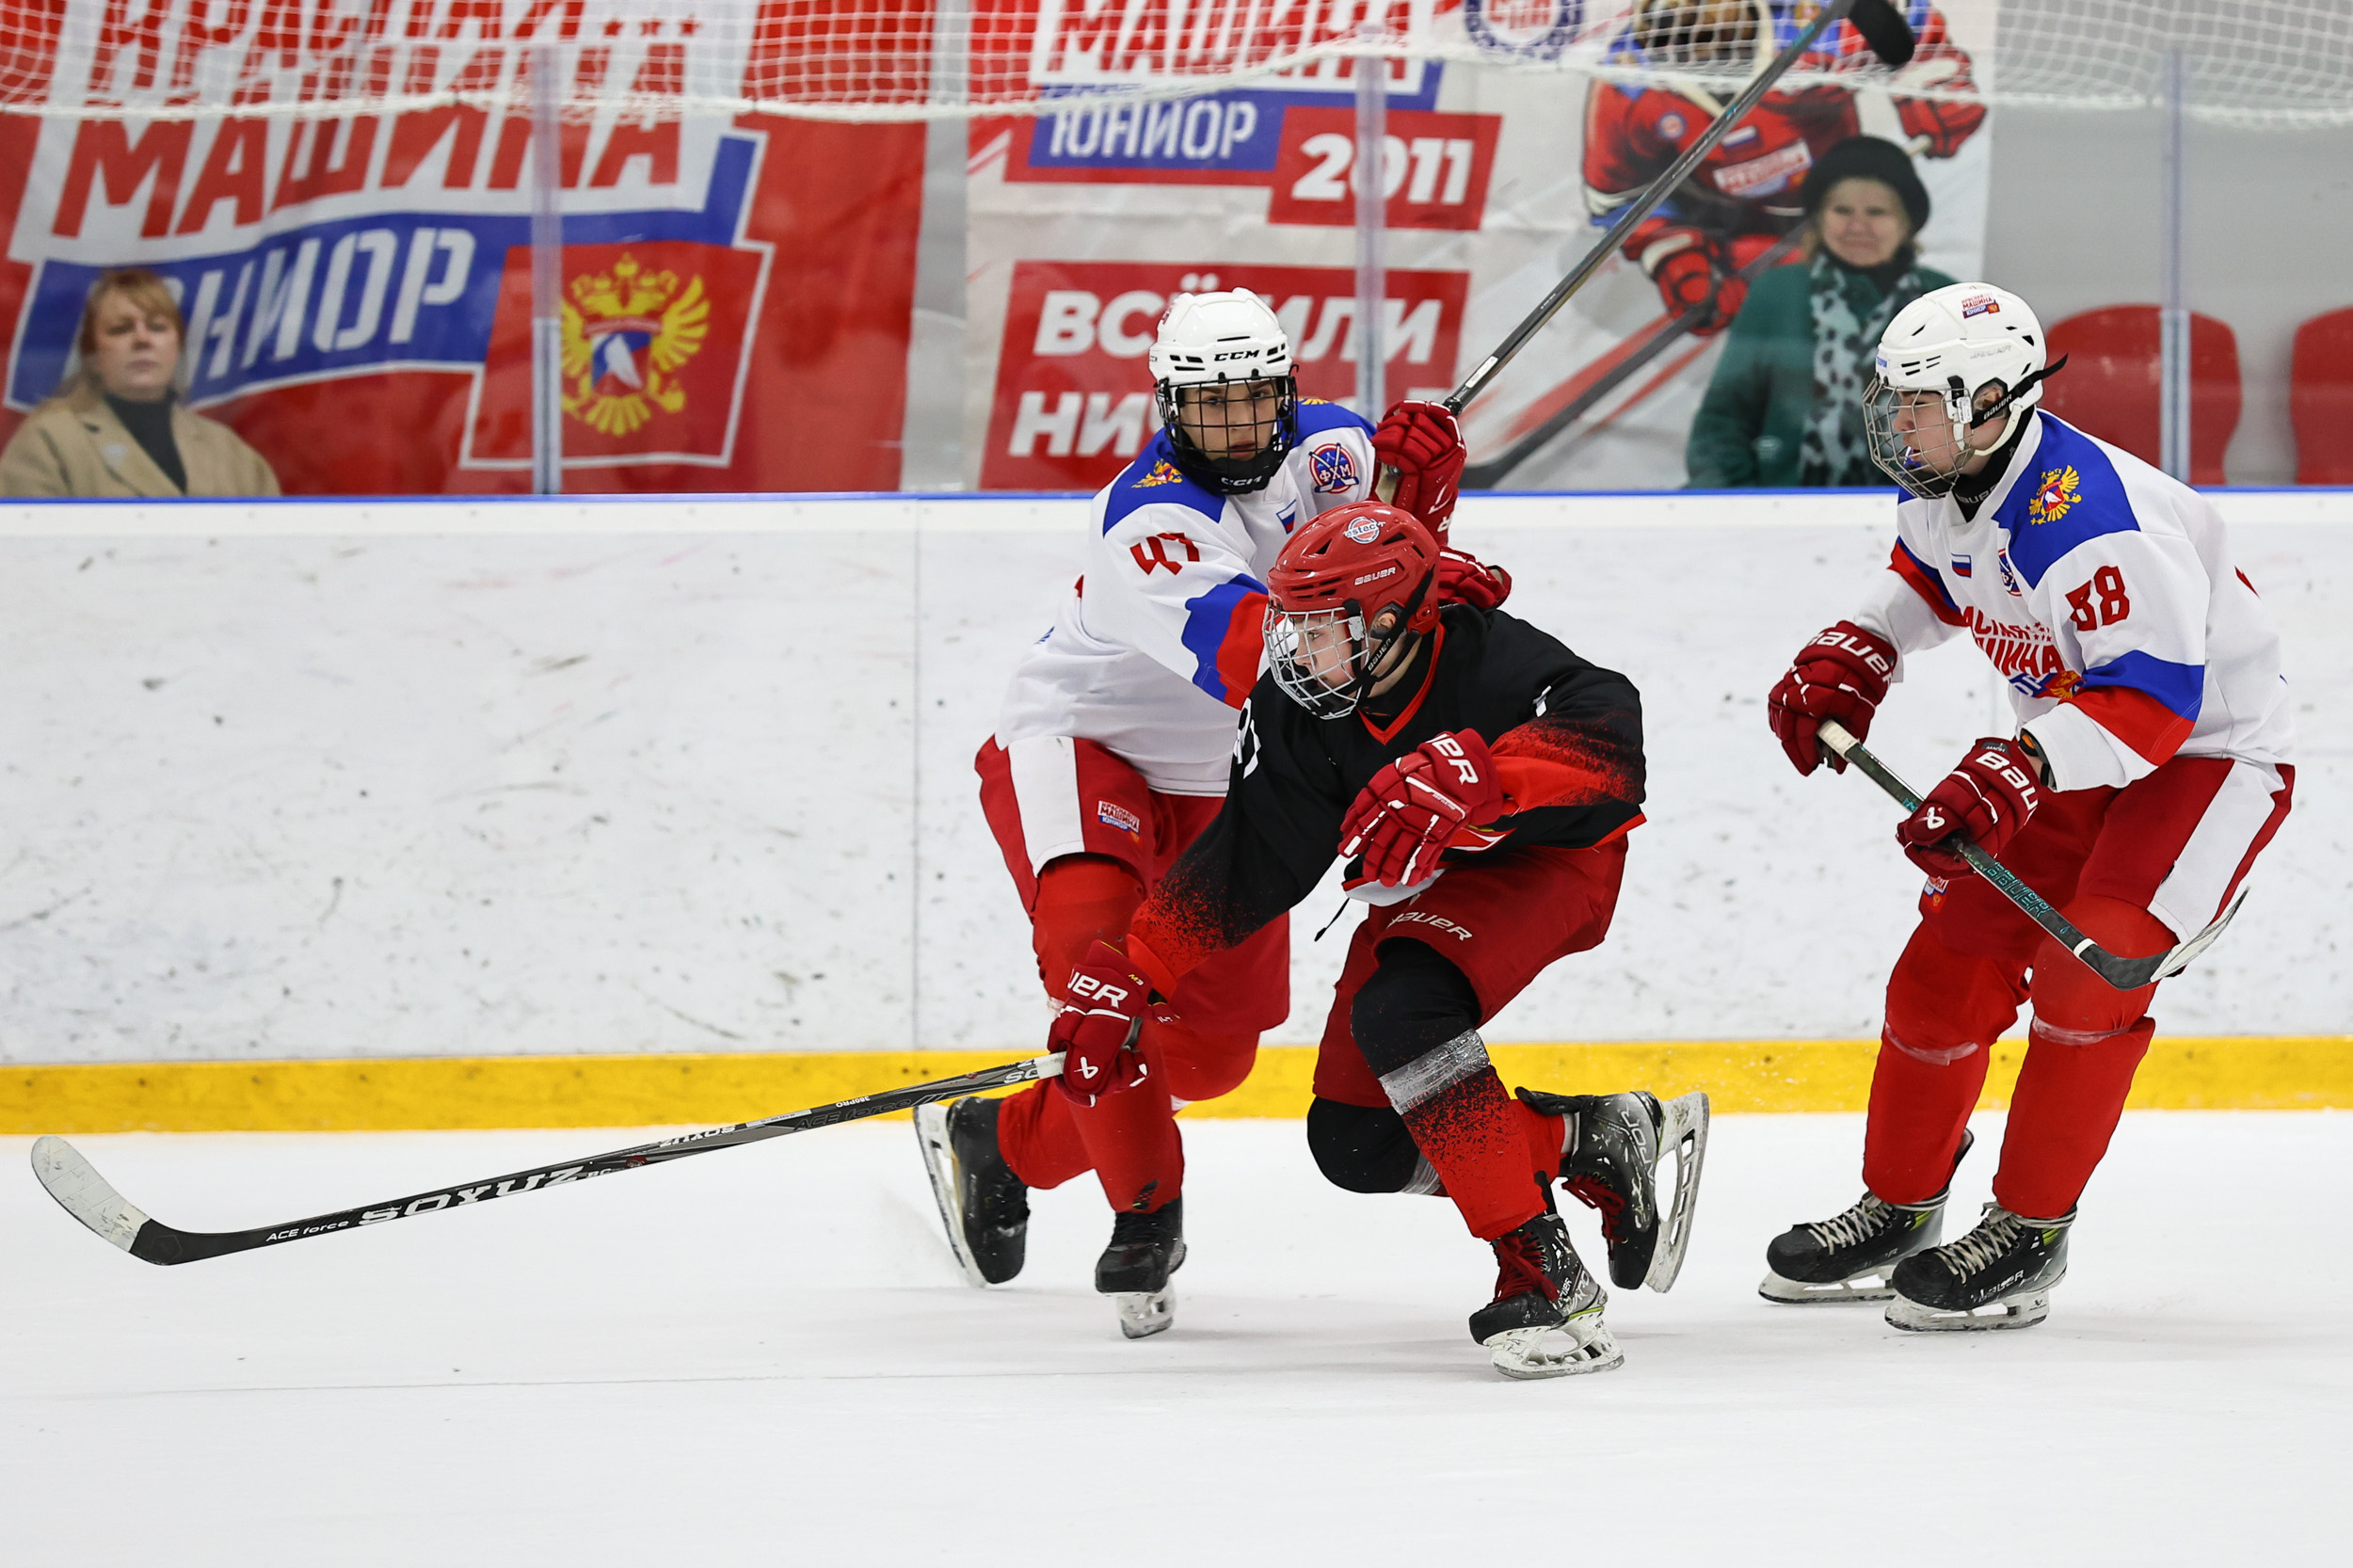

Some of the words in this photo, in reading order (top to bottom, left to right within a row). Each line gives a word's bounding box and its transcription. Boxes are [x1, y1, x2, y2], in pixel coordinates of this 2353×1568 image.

[52, 42, 688, 239] МАШИНА
[1048, 101, 1257, 158] ЮНИОР
[1292, 134, 1475, 202] 2011
[62, 228, 475, 380] НИОР
[1033, 273, 1220, 358] ВС
[1214, 349, 1260, 361] CCM
[1983, 393, 2012, 421] BAUER
[1319, 463, 1353, 483] ФХМ
[1129, 532, 1200, 576] 47
[1354, 567, 1397, 585] BAUER
[1368, 637, 1392, 671] BAUER
[265, 1226, 299, 1242] ACE
[303, 1220, 349, 1235] force
[357, 1165, 584, 1225] SOYUZ
